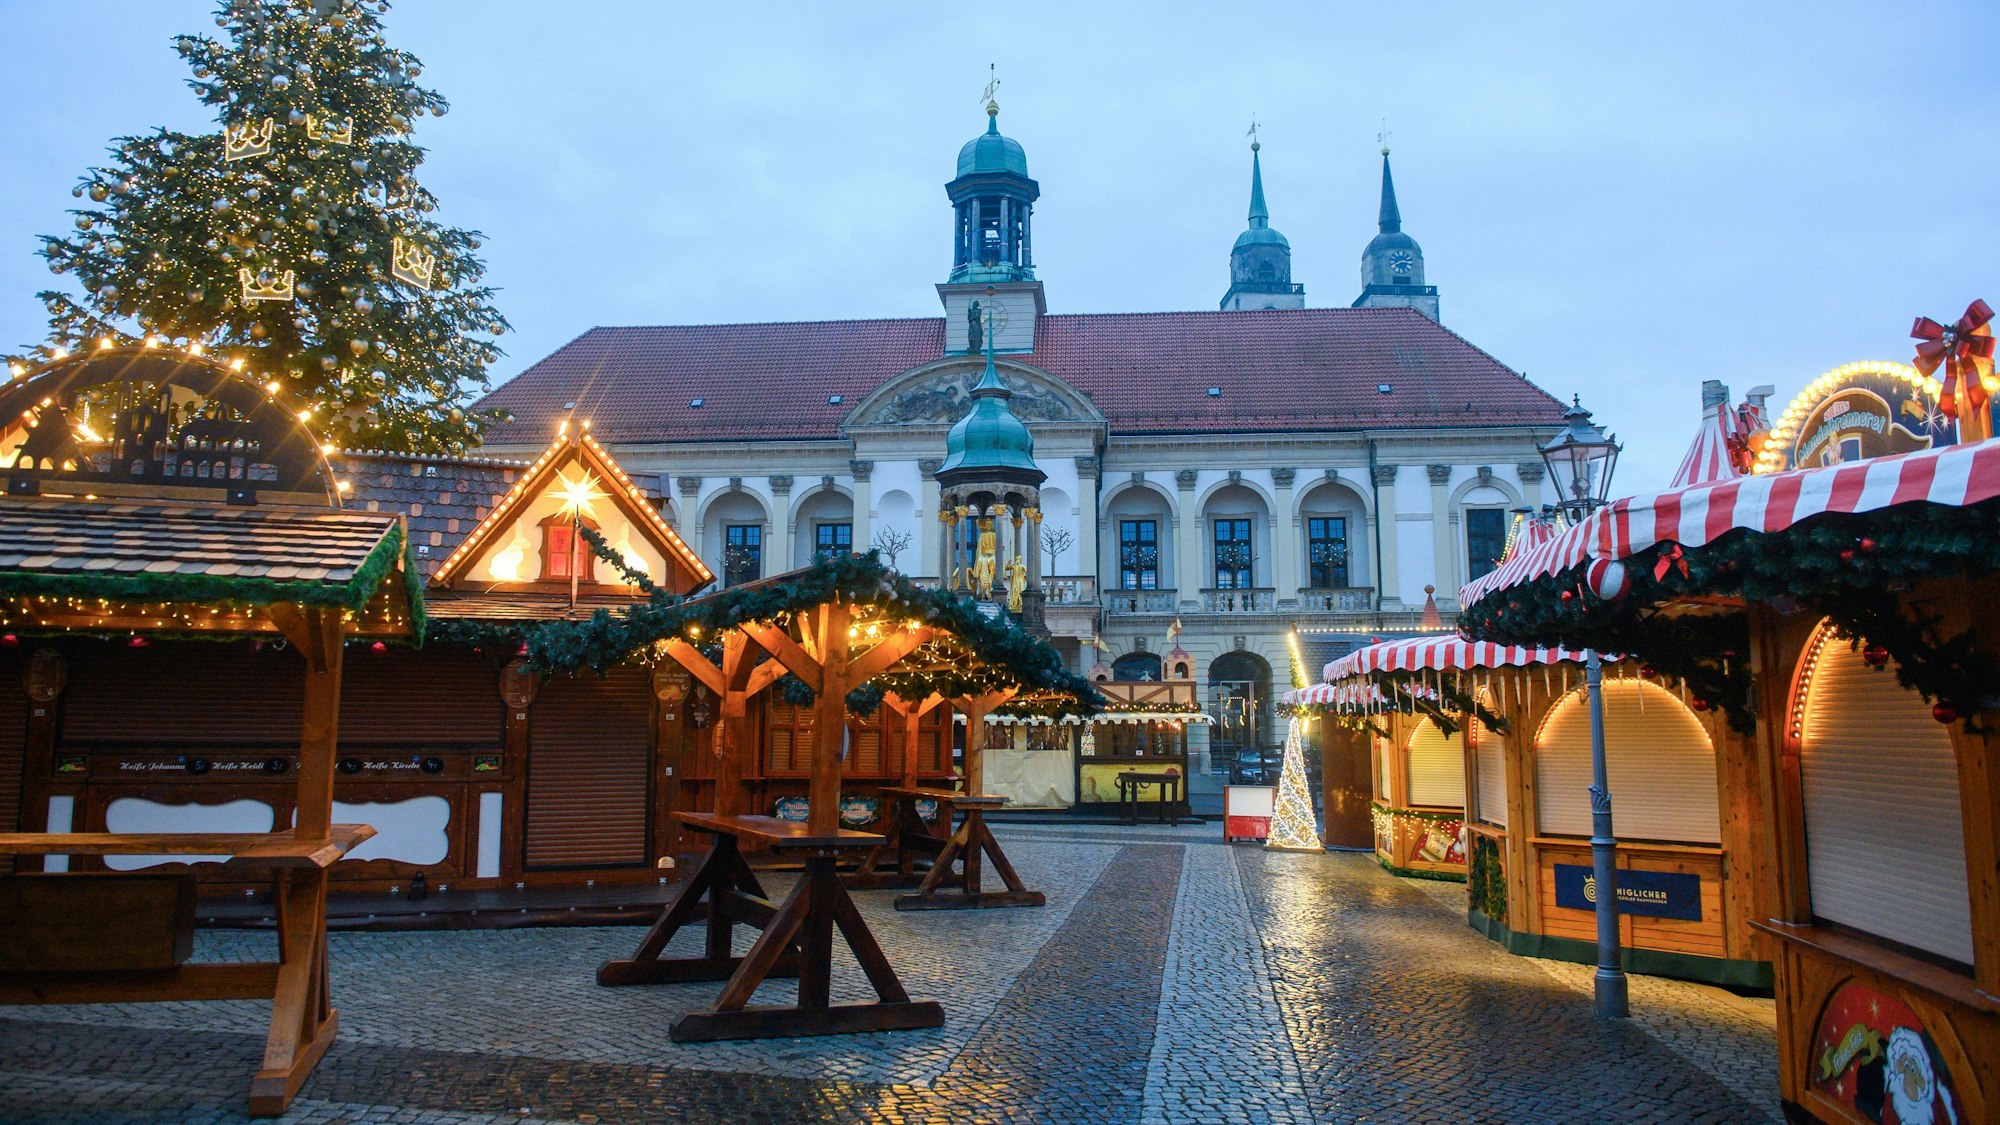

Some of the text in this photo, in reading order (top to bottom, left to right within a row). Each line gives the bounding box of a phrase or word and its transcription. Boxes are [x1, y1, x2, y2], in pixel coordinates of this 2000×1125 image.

[1798, 411, 1885, 467] Mandelbrennerei
[148, 762, 186, 771] Johanna
[240, 761, 265, 770] Heidi
[1616, 887, 1667, 900] NIGLICHER
